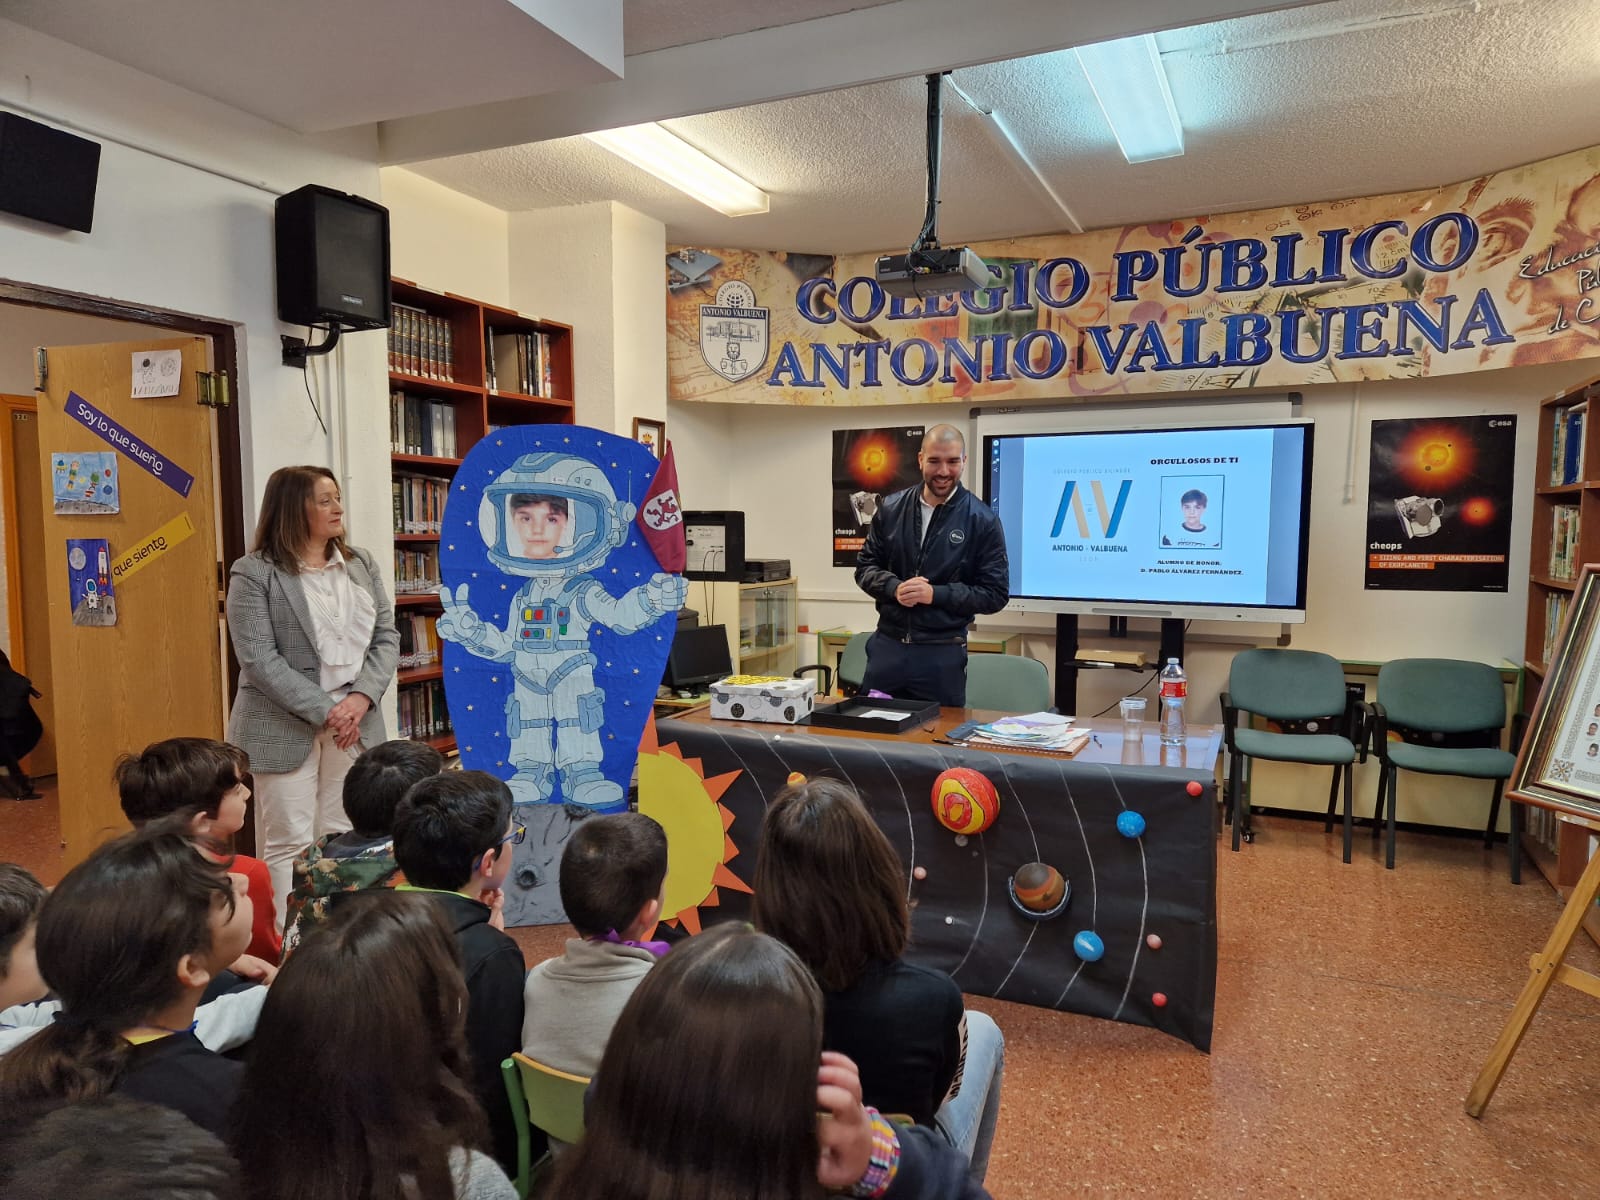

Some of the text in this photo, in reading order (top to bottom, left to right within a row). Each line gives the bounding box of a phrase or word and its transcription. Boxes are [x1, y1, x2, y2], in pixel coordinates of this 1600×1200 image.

[1111, 212, 1480, 301] PÚBLICO
[702, 307, 764, 318] ANTONIO VALBUENA
[1548, 303, 1569, 335] de
[765, 288, 1516, 390] ANTONIO VALBUENA
[77, 403, 163, 474] Soy lo que sueño
[113, 536, 168, 577] que siento
[1090, 545, 1128, 553] VALBUENA
[1370, 542, 1402, 551] cheops
